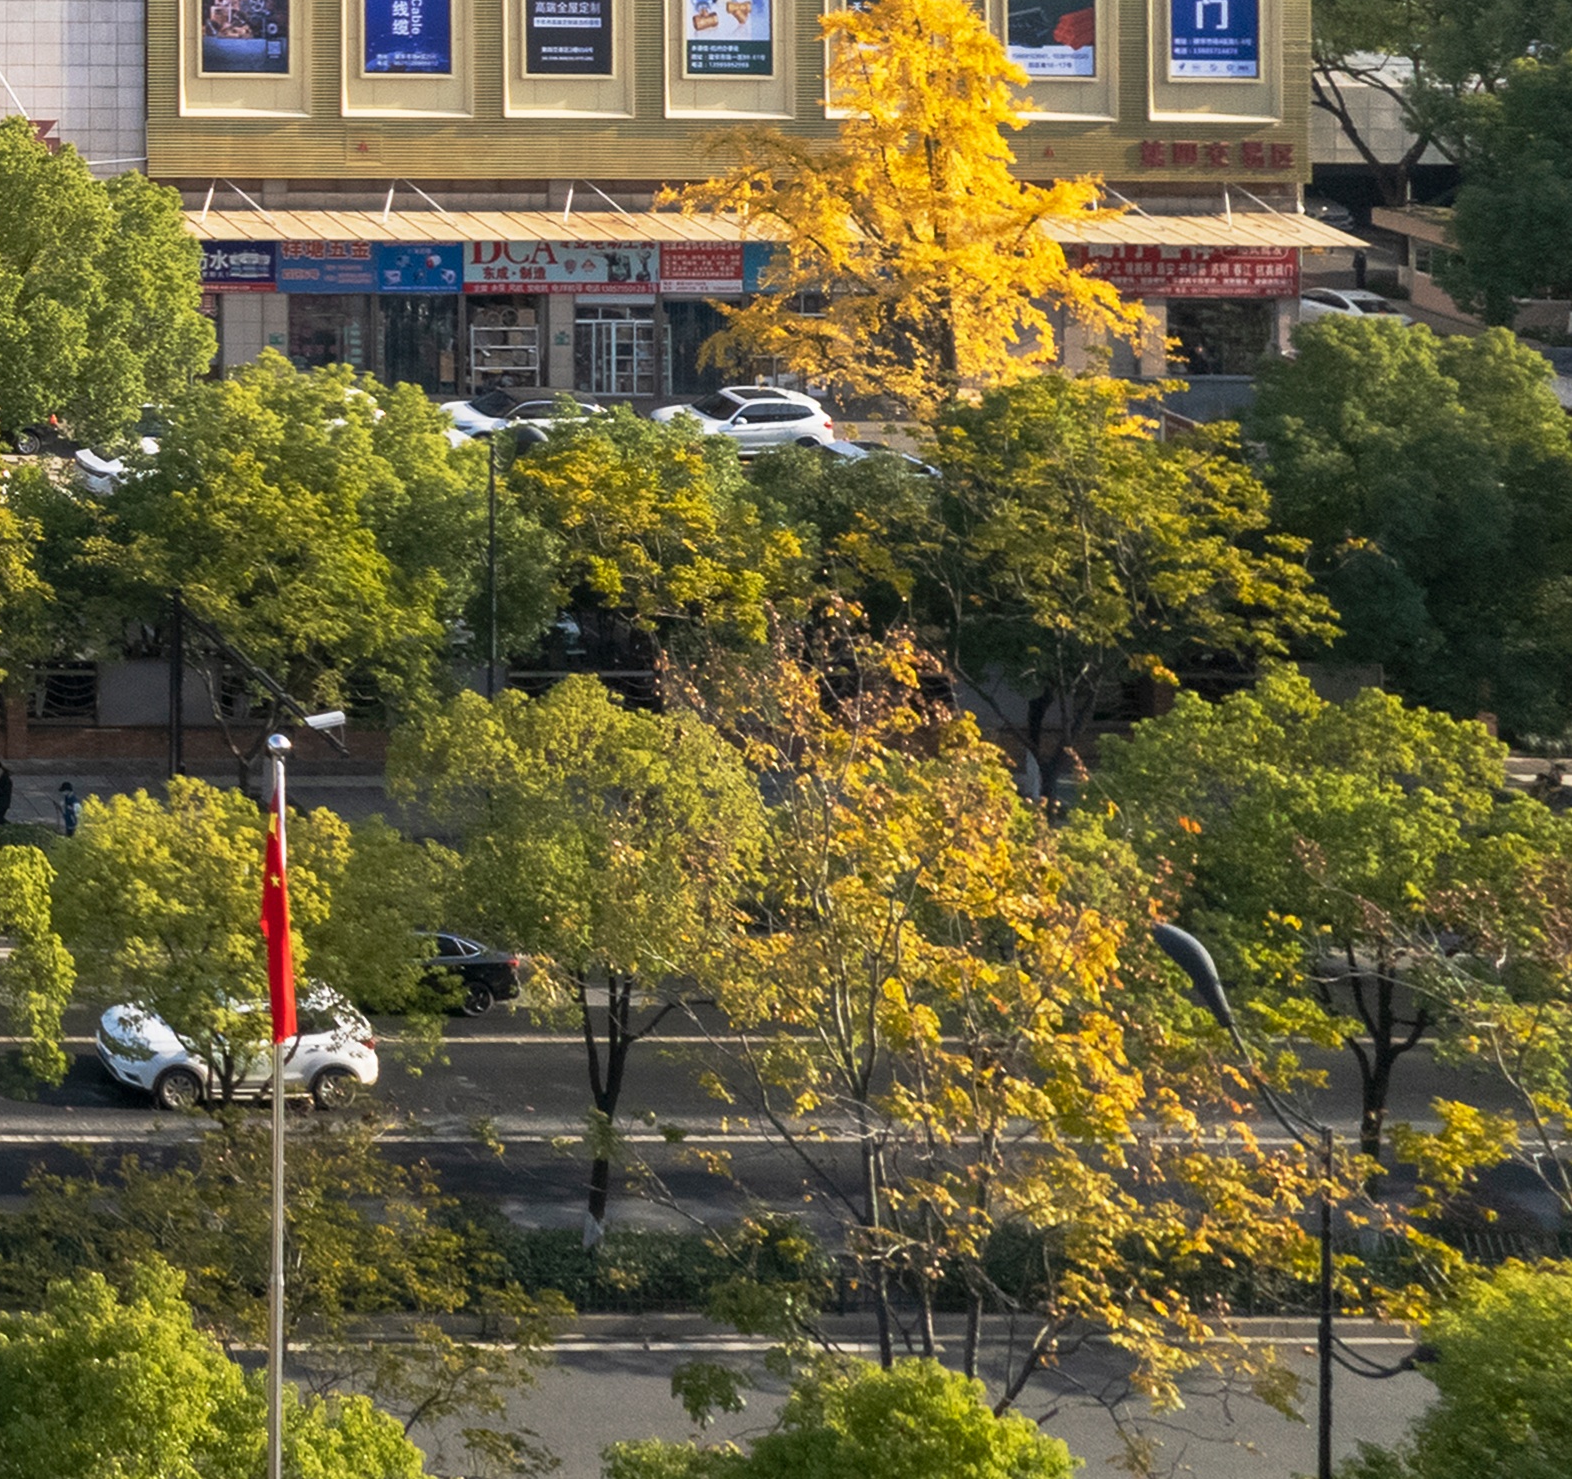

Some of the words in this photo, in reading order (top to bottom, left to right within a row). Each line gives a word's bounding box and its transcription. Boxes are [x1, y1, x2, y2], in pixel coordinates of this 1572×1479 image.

[535, 2, 601, 14] 高端全屋定制
[470, 241, 559, 265] DCA
